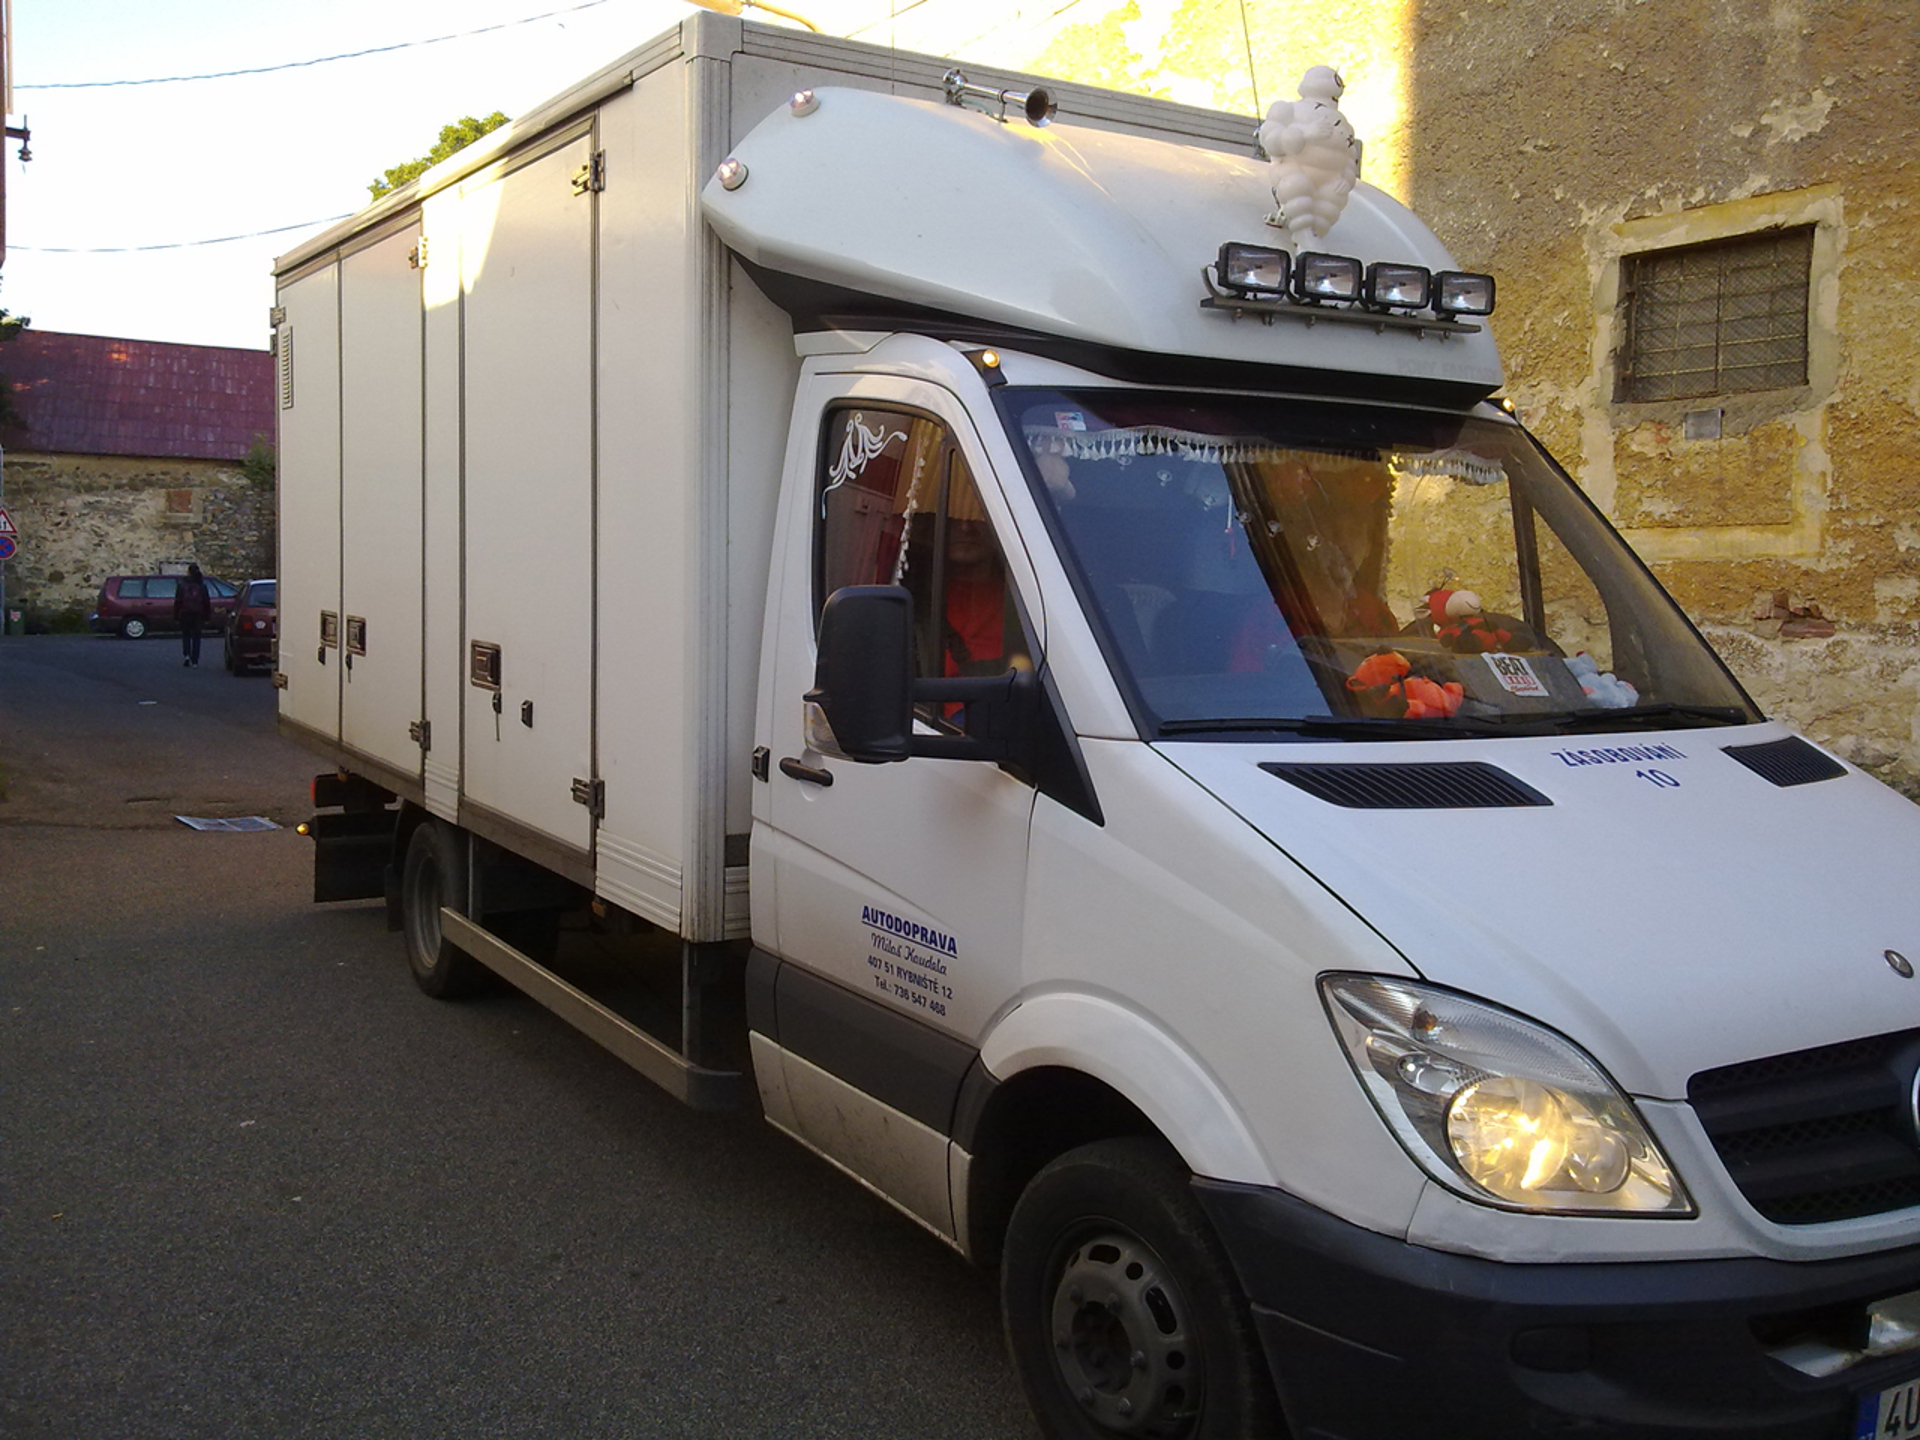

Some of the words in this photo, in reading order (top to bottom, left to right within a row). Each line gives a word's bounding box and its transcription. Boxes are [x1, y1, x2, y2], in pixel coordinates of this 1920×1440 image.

[1550, 742, 1688, 766] ZÁSOBOVÁNÍ
[1636, 769, 1681, 788] 10
[861, 905, 957, 955] AUTODOPRAVA
[884, 961, 894, 975] 51
[941, 985, 953, 1000] 12
[911, 991, 927, 1008] 547
